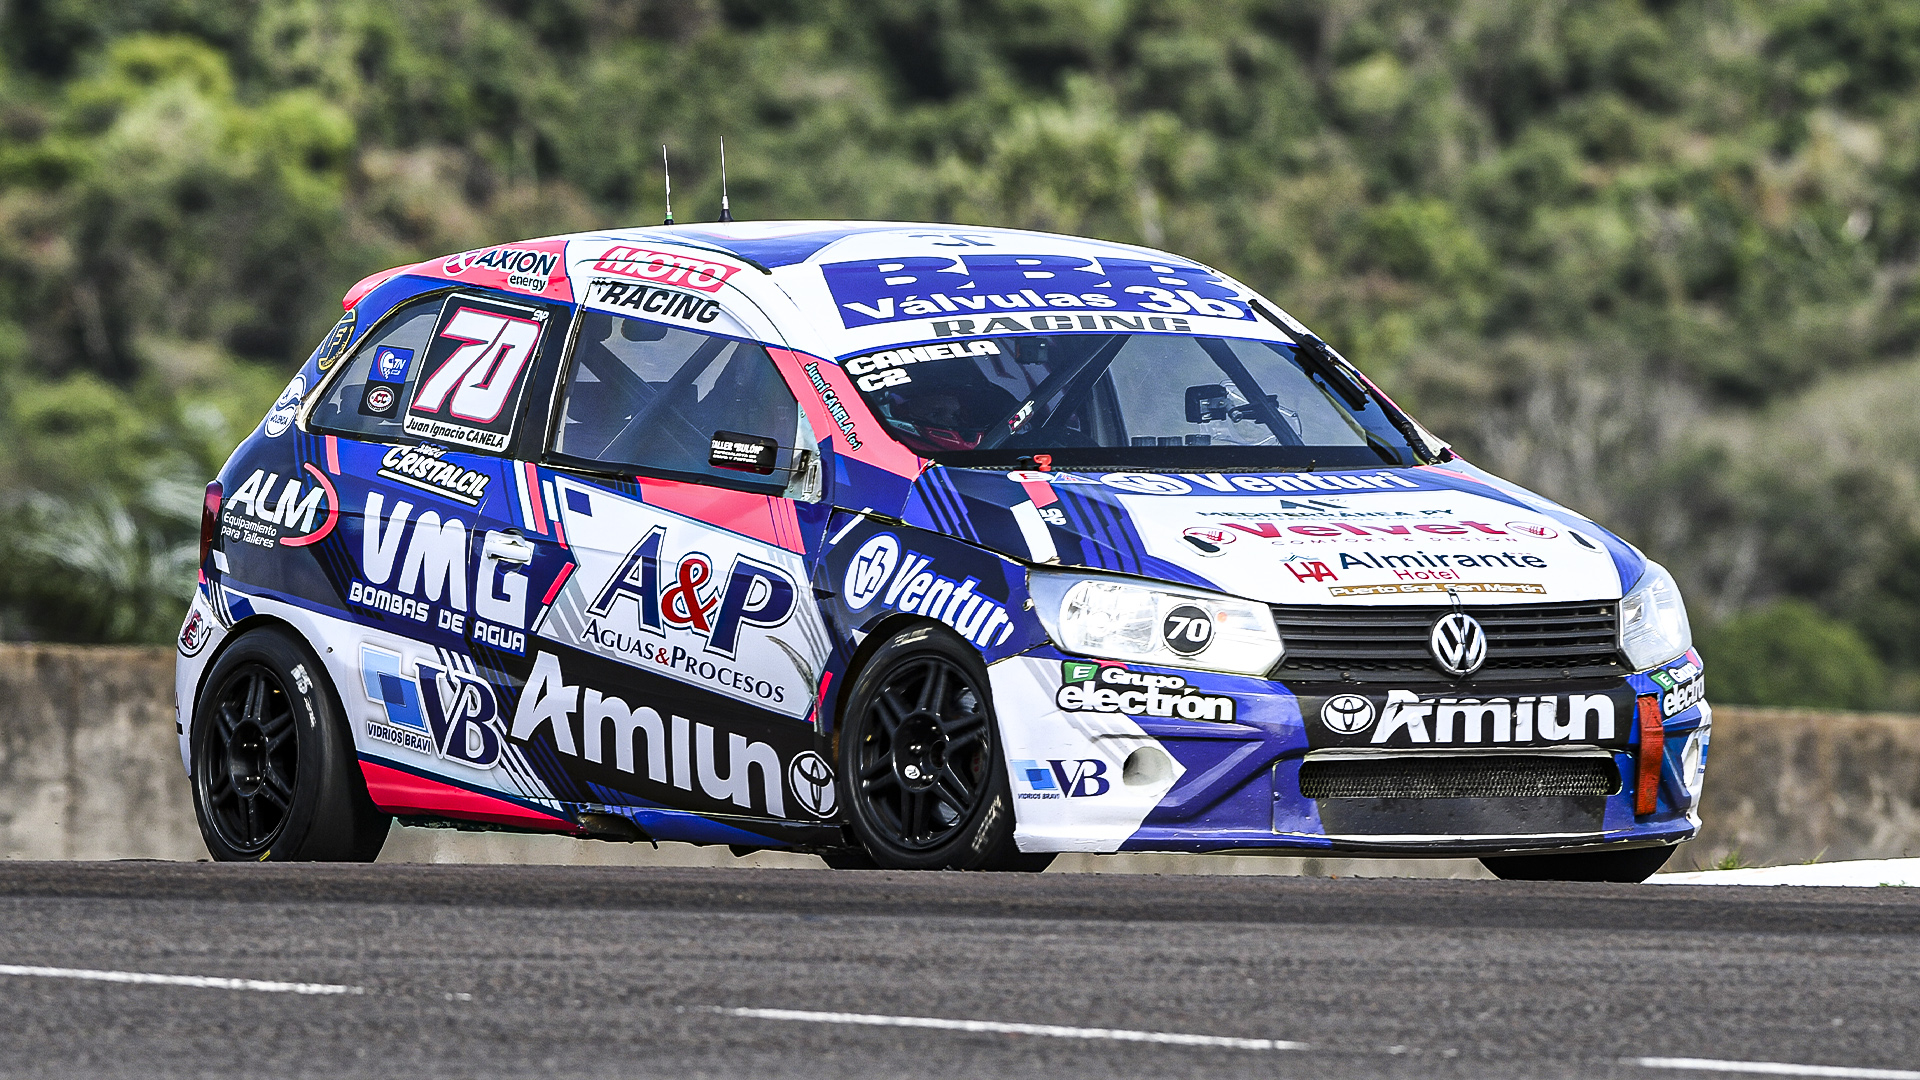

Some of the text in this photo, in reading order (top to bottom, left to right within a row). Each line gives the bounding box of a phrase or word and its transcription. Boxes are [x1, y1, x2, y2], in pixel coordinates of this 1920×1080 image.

[474, 250, 558, 277] AXION
[606, 247, 728, 287] MOTO
[509, 274, 547, 291] energy
[600, 281, 720, 323] RACING
[842, 285, 1246, 319] Válvulas 3b
[931, 315, 1191, 337] RACING
[412, 306, 540, 424] 70
[845, 340, 1000, 375] CANELA
[823, 388, 854, 434] CANELA
[406, 418, 504, 448] Juan Ignacio CANELA
[711, 440, 733, 451] TALLER
[382, 446, 490, 497] CRISTALCIL
[1179, 472, 1420, 493] Venturi
[225, 468, 326, 534] ALM
[220, 525, 275, 548] para Talleres
[223, 511, 277, 537] Equipamiento
[1217, 520, 1508, 538] Velvet
[362, 491, 535, 628] VMG
[1338, 550, 1548, 569] Almirante
[1393, 568, 1460, 580] Hotel
[586, 525, 799, 661] A&P
[1331, 584, 1397, 596] Puerto
[1447, 583, 1482, 593] San
[350, 581, 526, 653] BOMBAS DE AGUA
[1168, 615, 1211, 642] 70
[581, 619, 785, 703] AGUAS&PROCESOS
[1101, 667, 1186, 690] Grupo
[414, 662, 499, 765] VB
[1057, 681, 1233, 722] electrón
[1370, 690, 1615, 744] Amiun
[367, 722, 431, 753] VIDRIOS BRAVI
[510, 650, 785, 819] Amiun
[1046, 759, 1110, 798] VB
